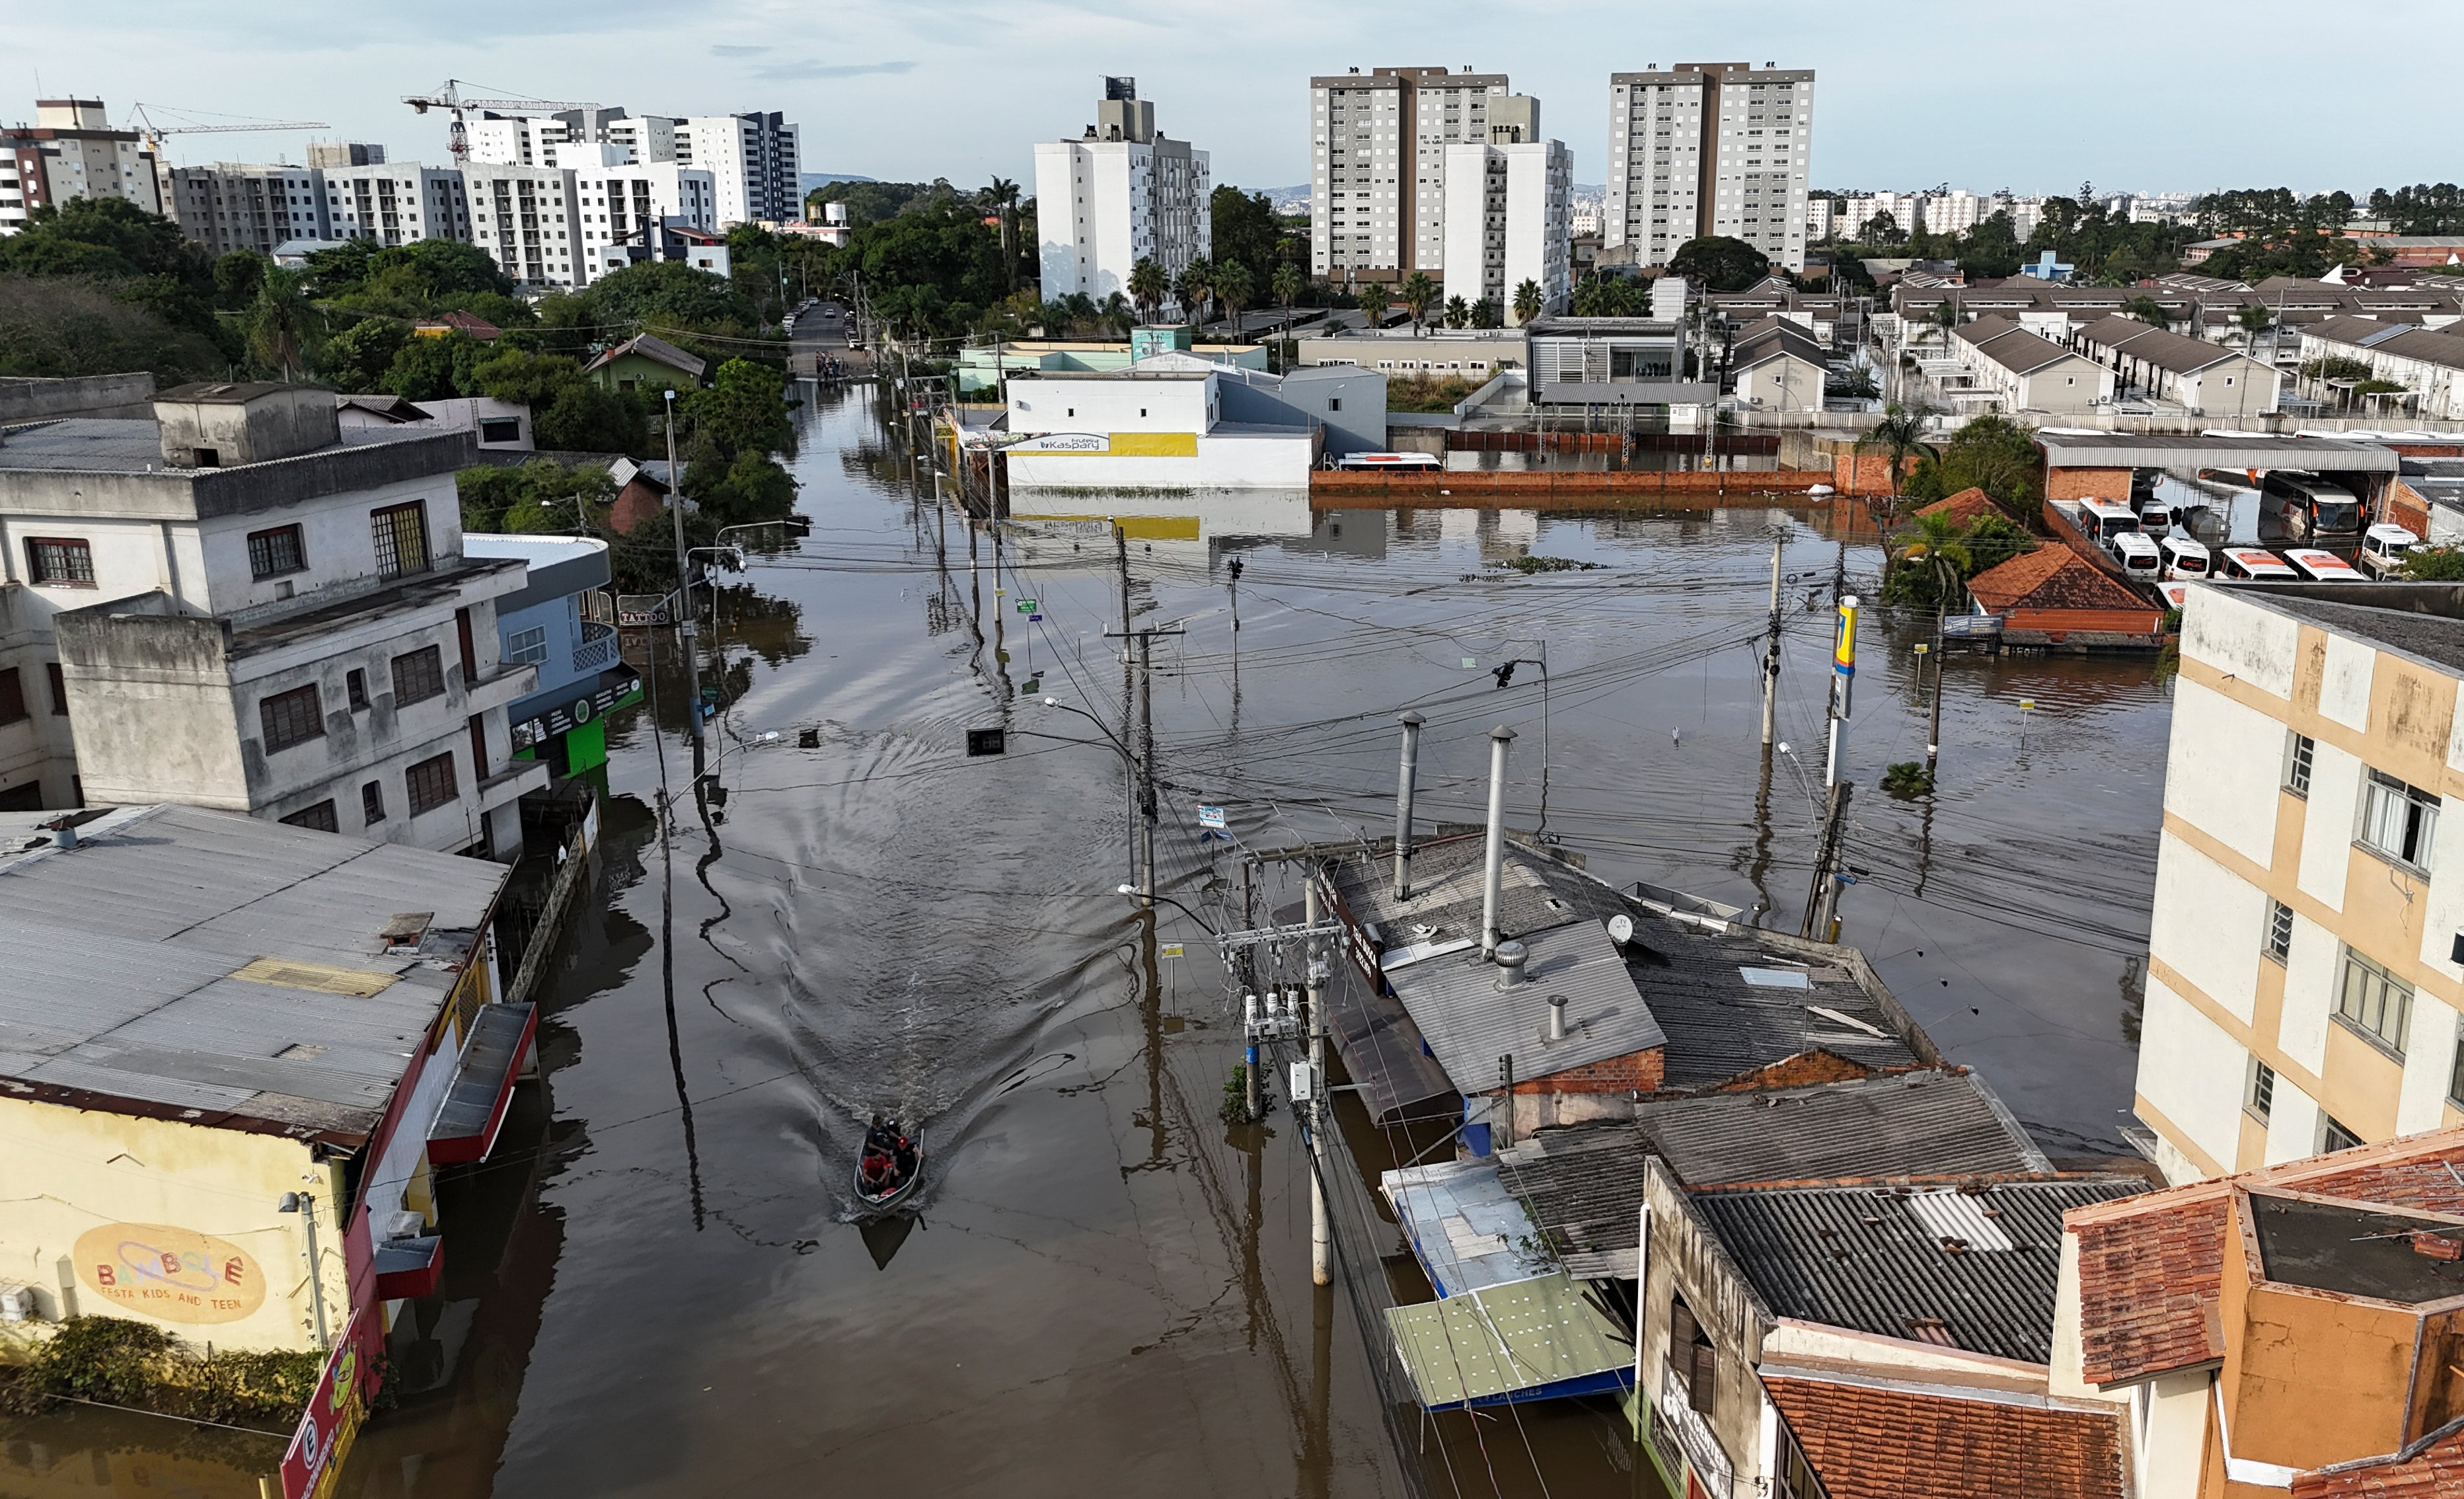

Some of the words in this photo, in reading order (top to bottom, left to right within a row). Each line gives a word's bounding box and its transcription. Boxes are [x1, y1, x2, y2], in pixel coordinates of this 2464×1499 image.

[1050, 441, 1100, 450] Kaspary
[2183, 560, 2202, 568] Local
[622, 612, 666, 621] TATTOO
[97, 1252, 244, 1286] BAMBOLÊ
[101, 1287, 135, 1299] FESTA
[143, 1289, 170, 1299] KIDS
[178, 1293, 201, 1306] AND
[211, 1299, 241, 1310] TEEN
[1493, 1389, 1542, 1401] LANCHES
[307, 1429, 314, 1457] E
[1694, 1414, 1725, 1475] CENTER
